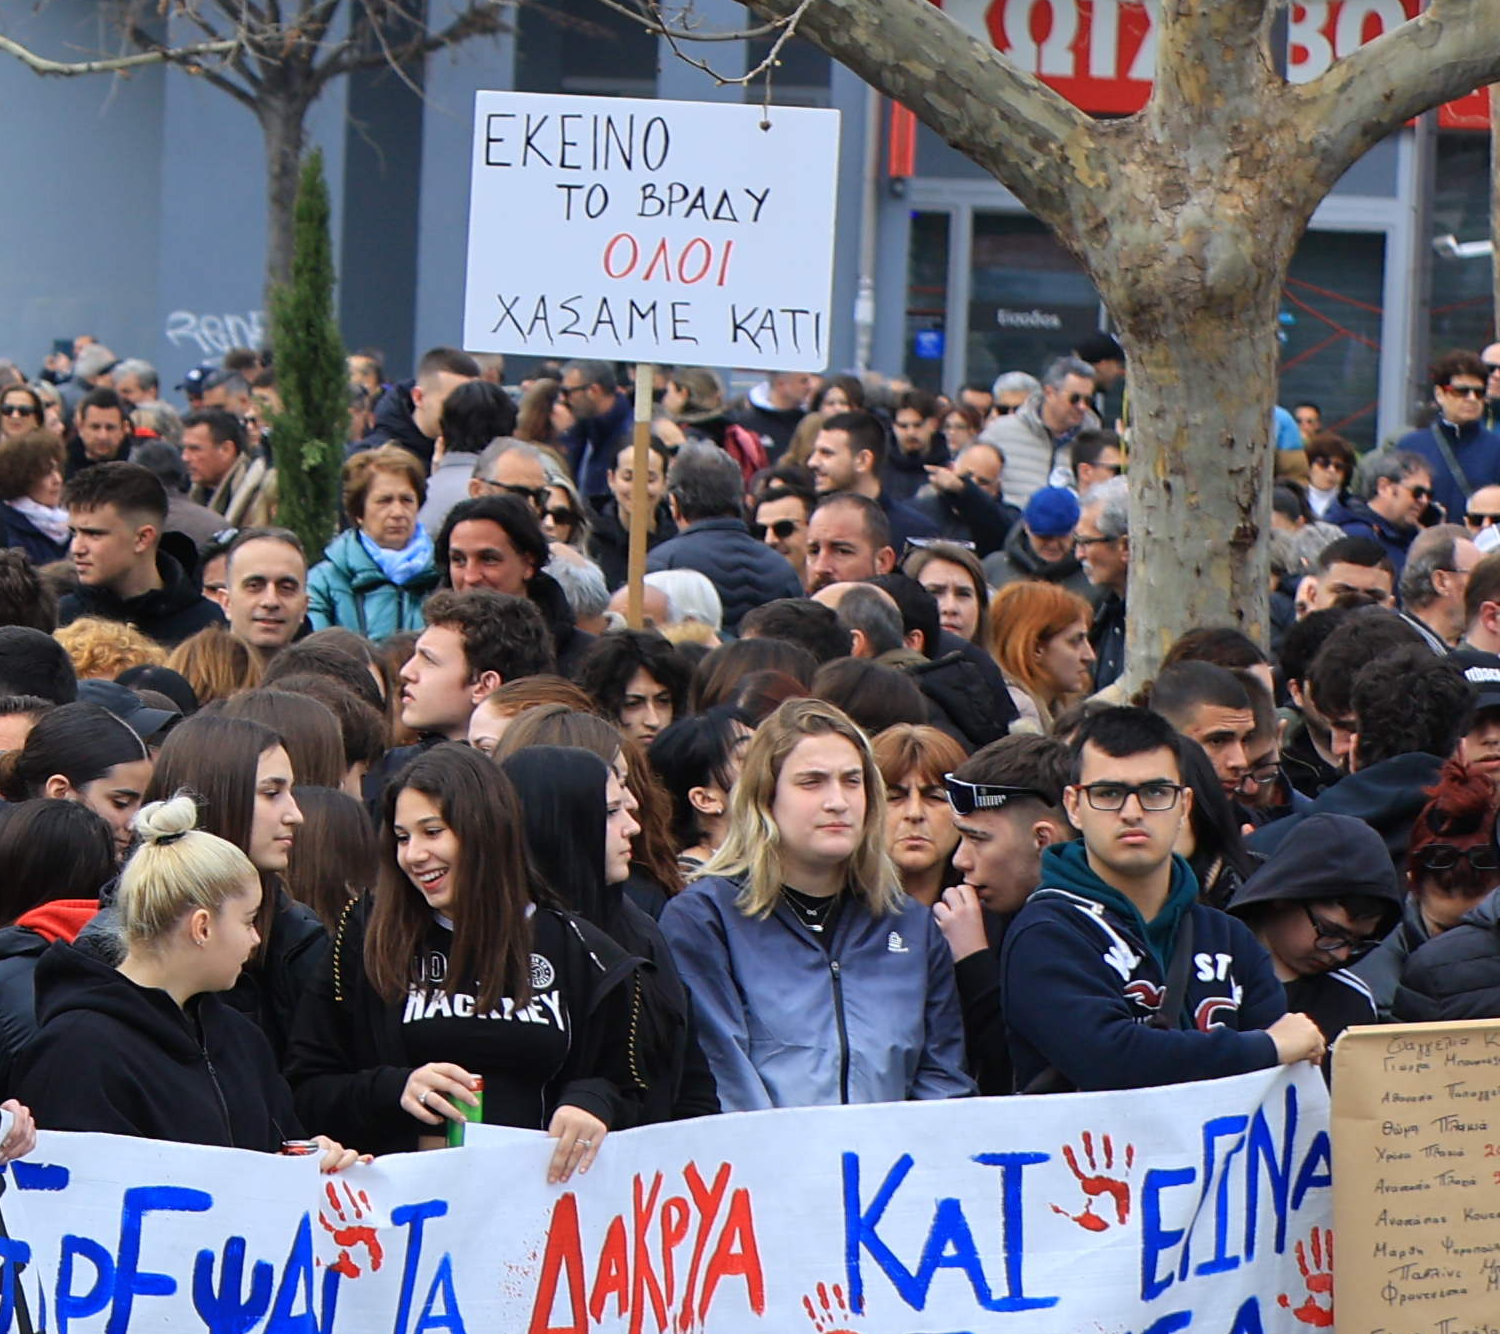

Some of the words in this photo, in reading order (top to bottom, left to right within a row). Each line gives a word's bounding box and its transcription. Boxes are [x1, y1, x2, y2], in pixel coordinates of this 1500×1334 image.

[484, 113, 669, 171] ΕΚΕΙΝΟ
[556, 183, 609, 221] ΤΟ
[637, 182, 770, 223] ΒΡΑΔΥ
[604, 232, 733, 286] ΟΛΟΙ
[490, 294, 698, 346] ΧΑΣΑΜΕ
[731, 304, 821, 358] ΚΑΤΙ
[841, 1151, 1061, 1314] ΚΑΙ
[1141, 1083, 1333, 1302] ΕΓΙΝΑ
